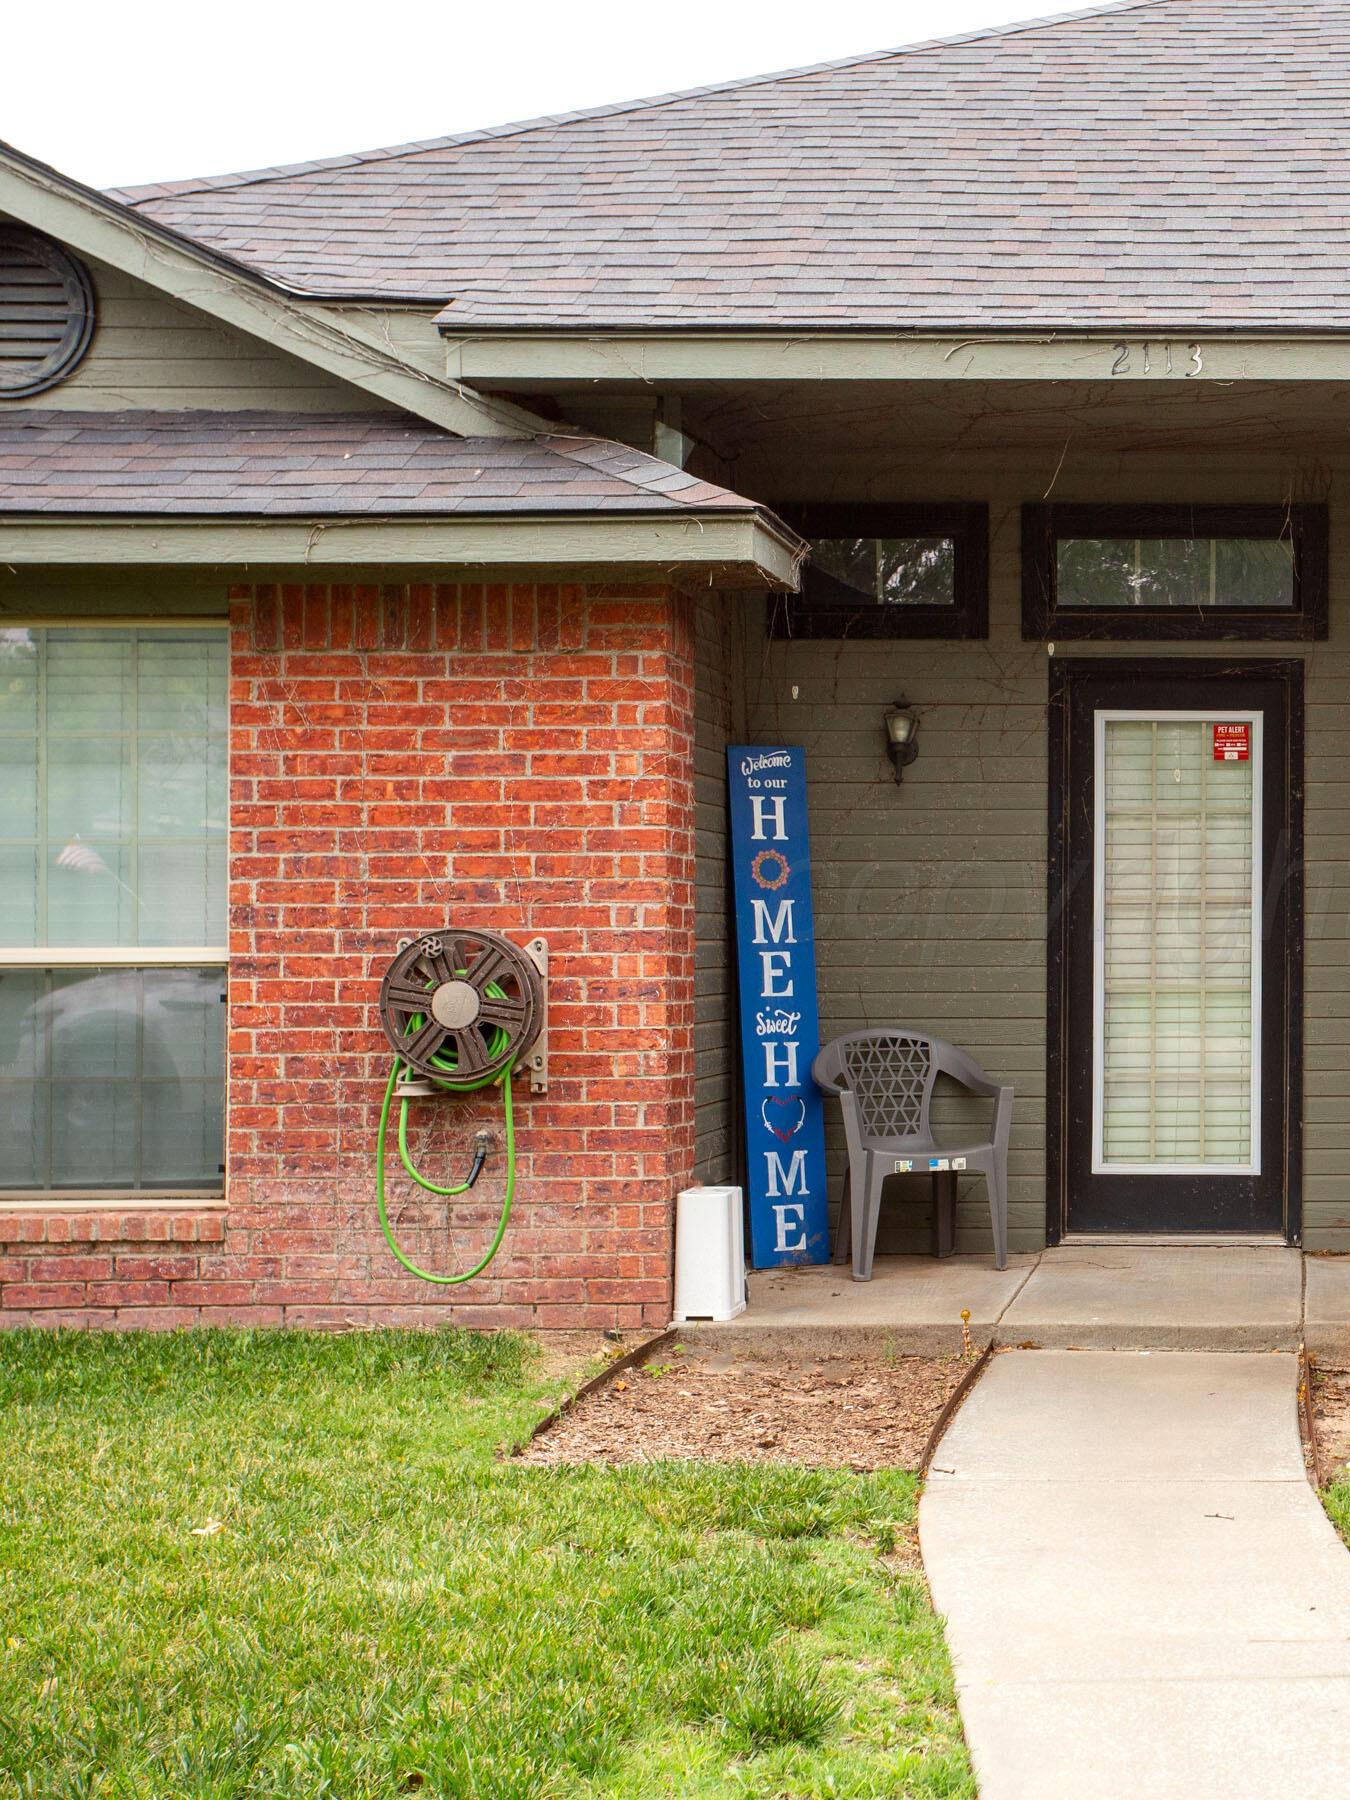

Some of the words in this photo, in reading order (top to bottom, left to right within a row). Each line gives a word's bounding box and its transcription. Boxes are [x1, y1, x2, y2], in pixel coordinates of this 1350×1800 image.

[1111, 341, 1204, 377] 2113
[741, 750, 791, 776] Welcome
[747, 777, 761, 788] to
[764, 778, 788, 789] our
